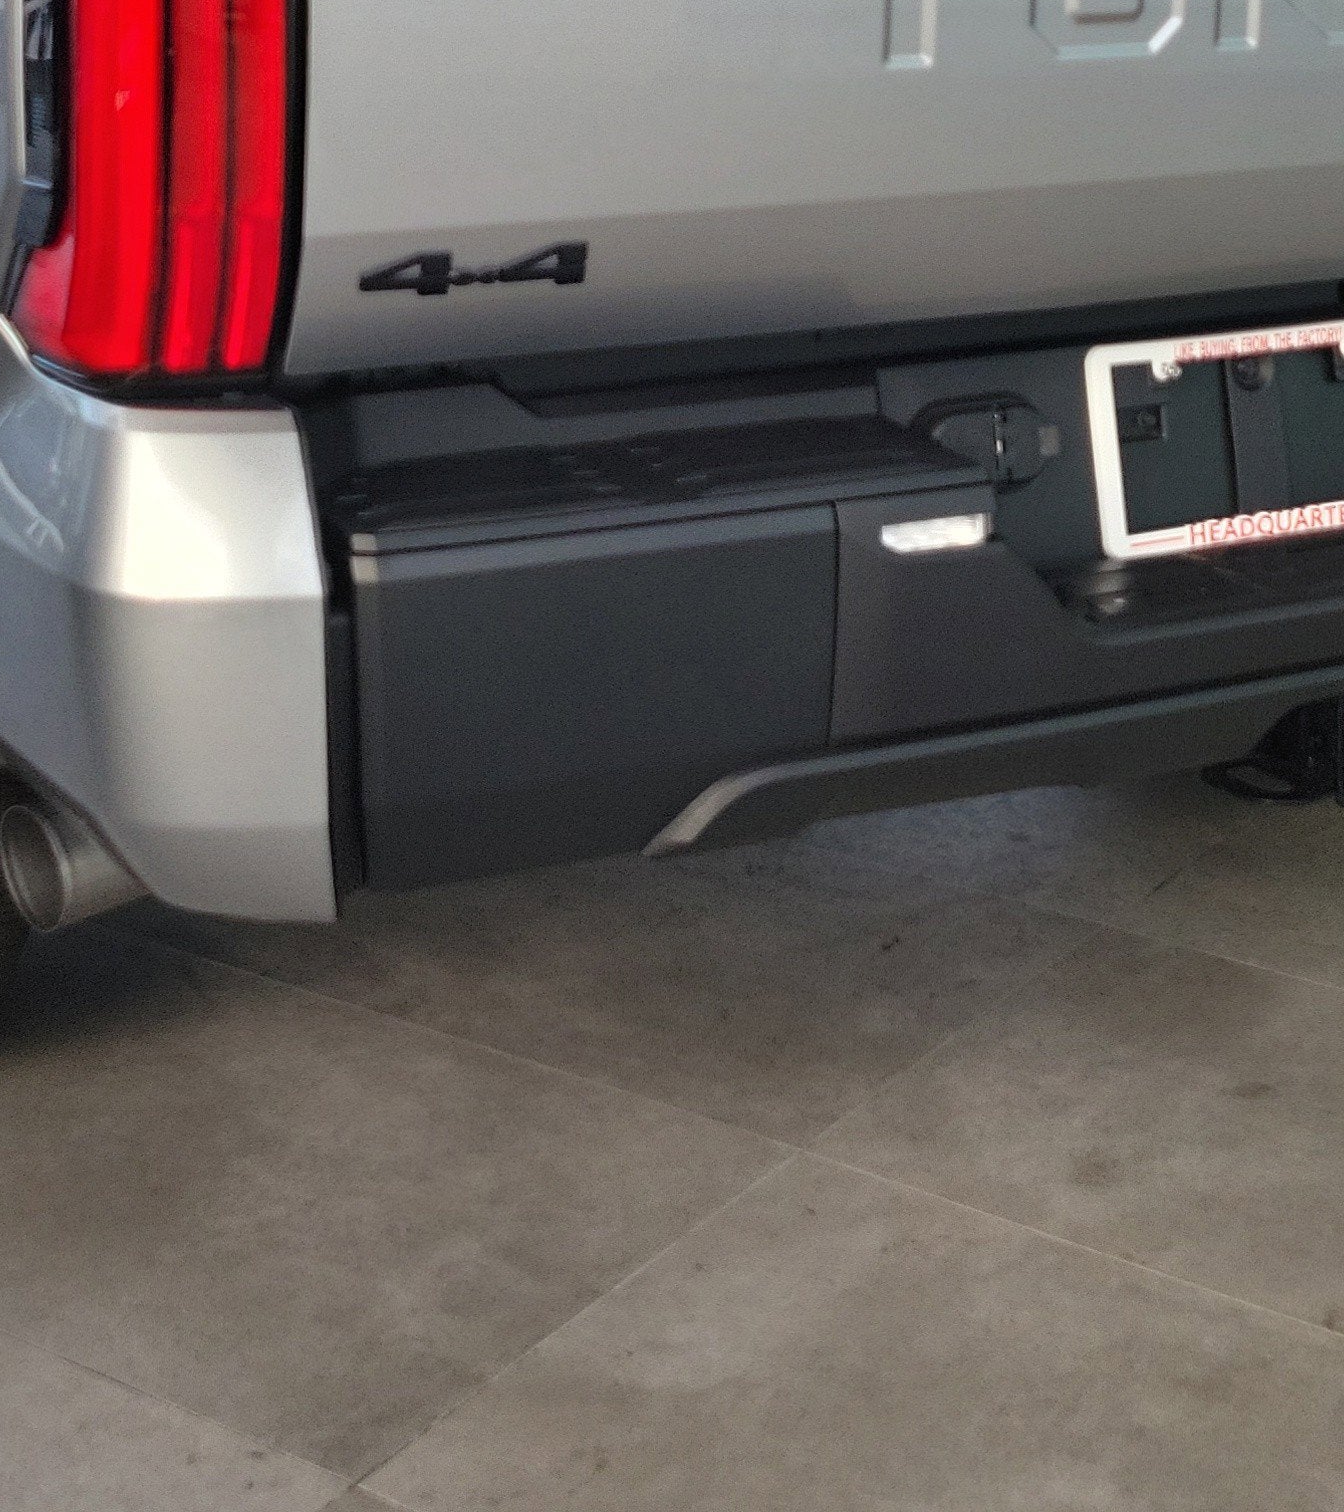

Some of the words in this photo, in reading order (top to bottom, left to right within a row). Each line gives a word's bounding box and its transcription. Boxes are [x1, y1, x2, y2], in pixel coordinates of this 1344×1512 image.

[1173, 341, 1195, 361] LIKE
[1199, 338, 1236, 360] BUYING
[1240, 334, 1269, 354] FROM
[1273, 331, 1293, 350] THE
